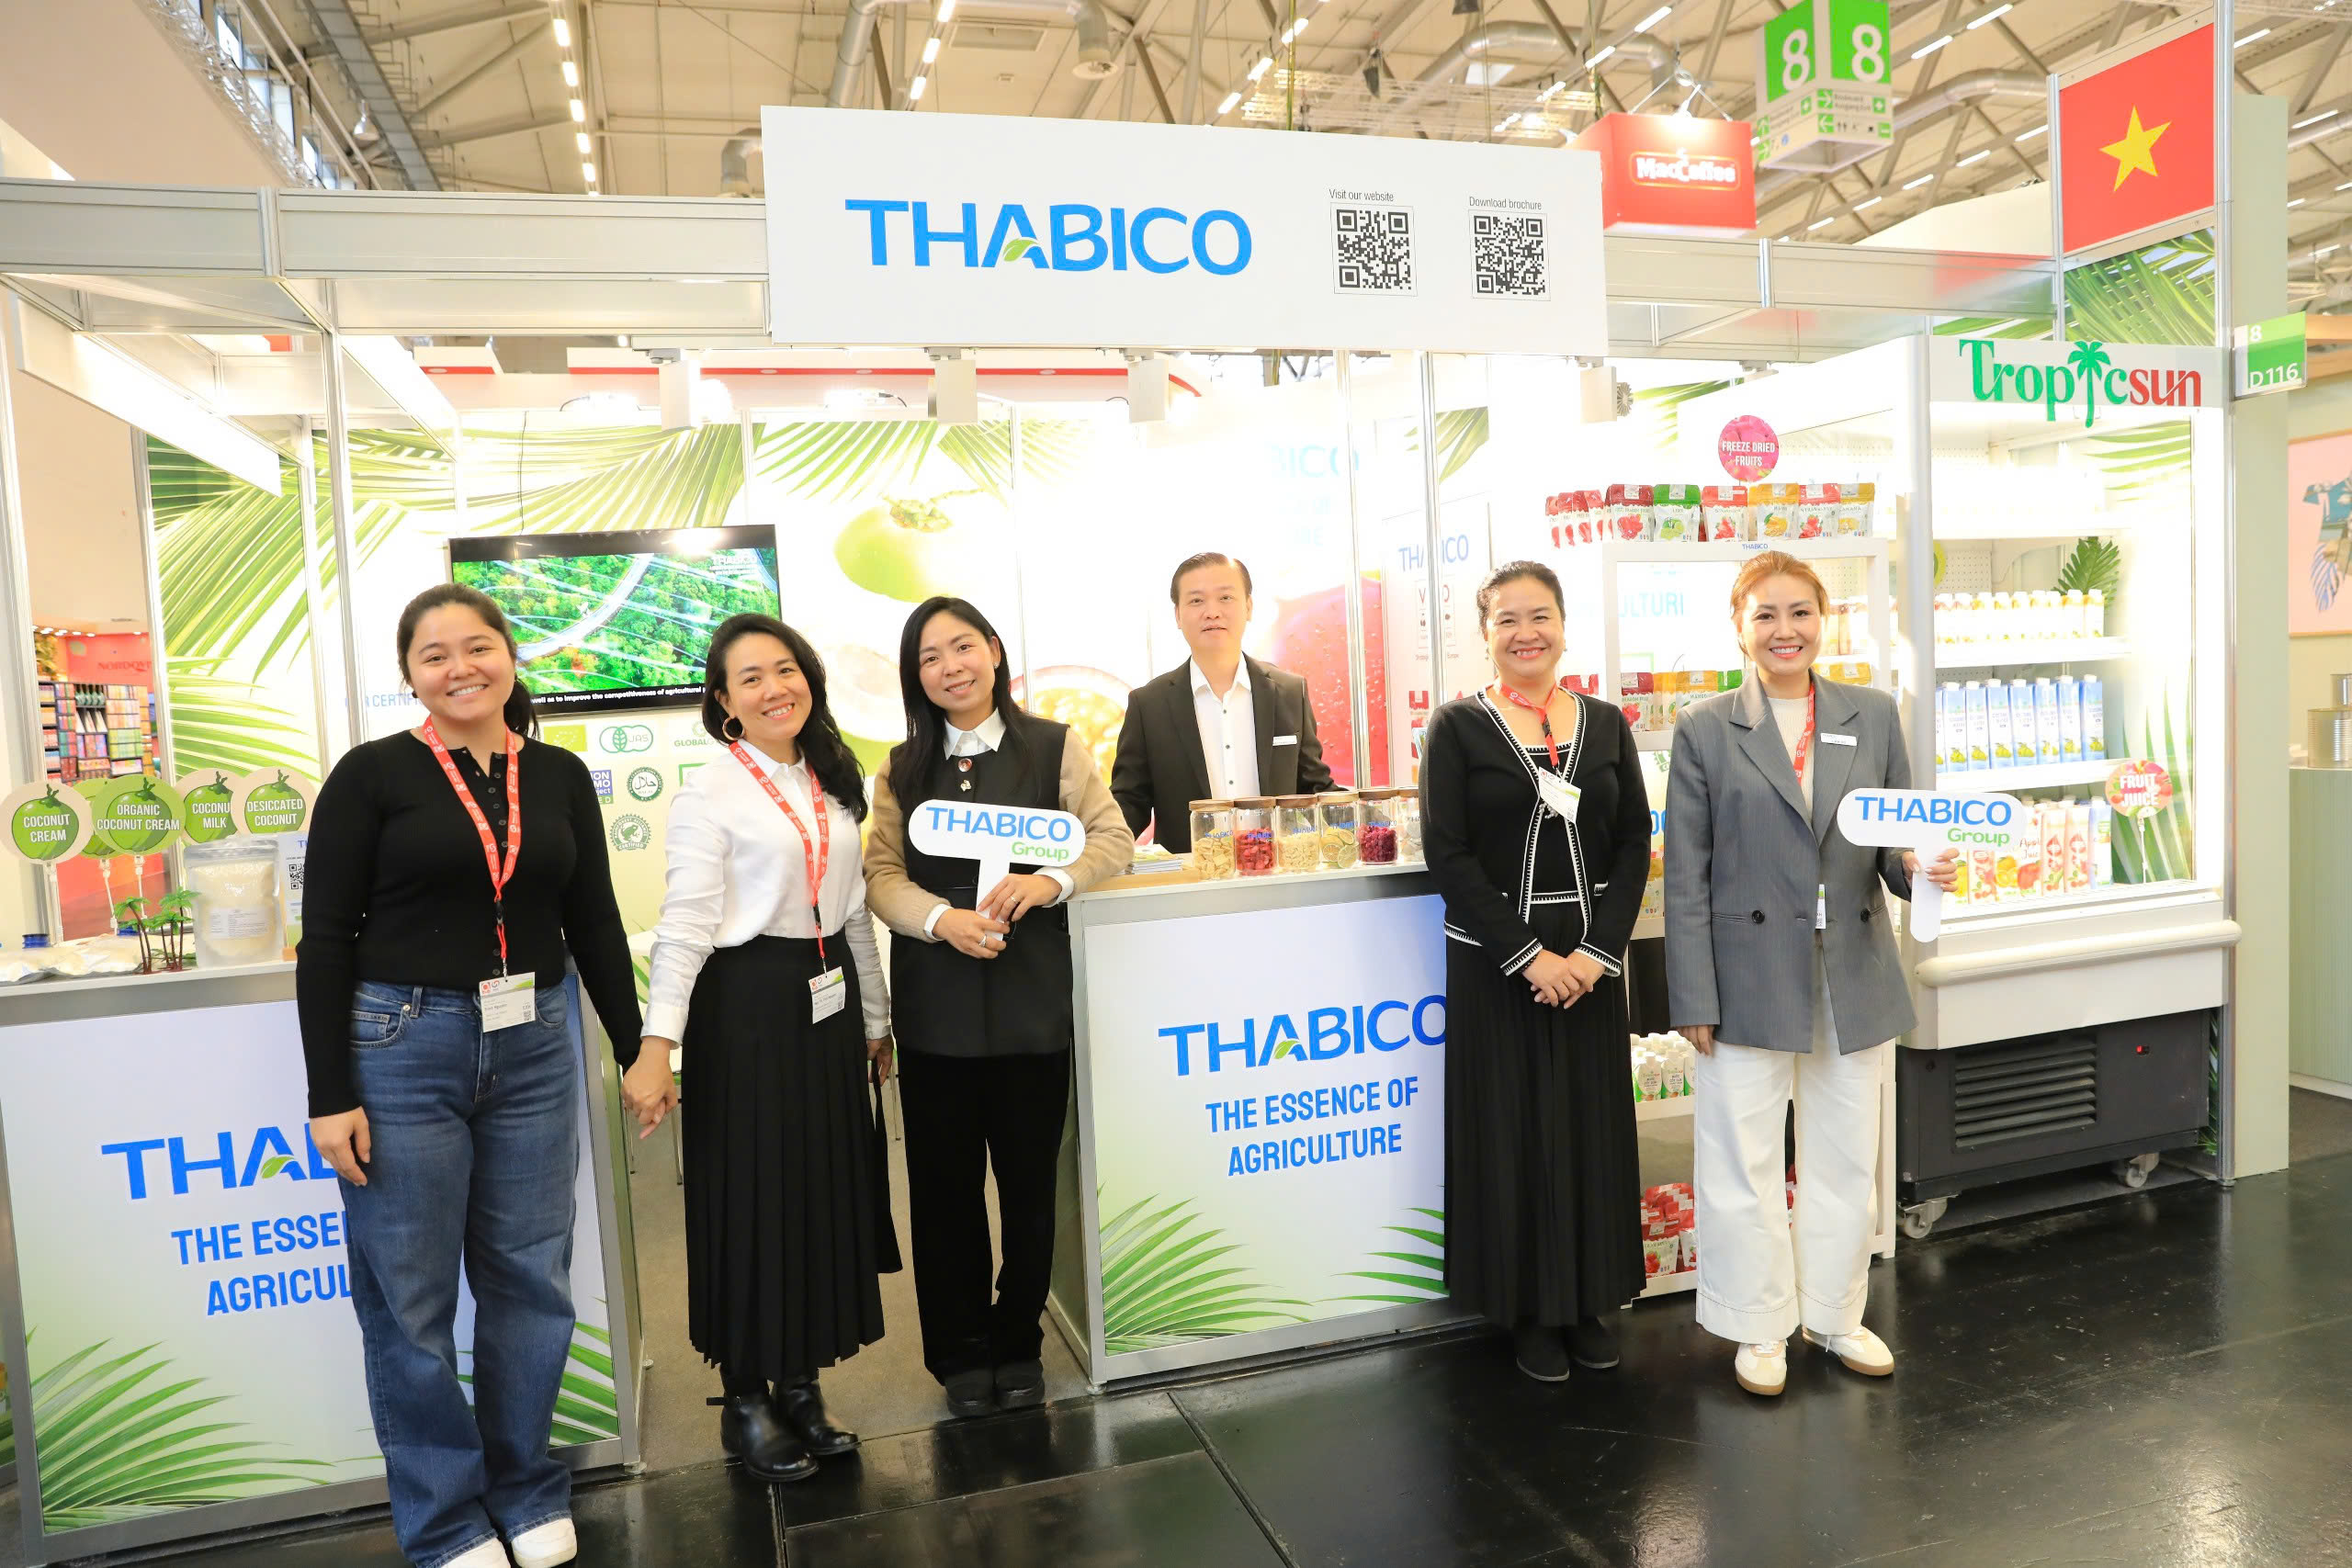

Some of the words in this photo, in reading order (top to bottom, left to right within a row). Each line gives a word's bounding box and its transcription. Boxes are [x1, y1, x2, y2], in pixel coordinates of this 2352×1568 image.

[1781, 28, 1810, 92] 8
[1851, 23, 1884, 84] 8
[1329, 188, 1347, 200] Visit
[1348, 192, 1363, 201] our
[1363, 191, 1394, 202] website
[1469, 196, 1507, 209] Download
[1508, 197, 1543, 210] brochure
[844, 198, 1252, 276] THABICO
[2249, 324, 2263, 343] 8
[1722, 441, 1750, 453] FREEZE
[1752, 442, 1776, 453] DRIED
[1735, 455, 1763, 467] FRUITS
[564, 694, 591, 703] improve
[657, 687, 664, 695] of
[665, 685, 702, 696] agricultural
[673, 739, 715, 748] GLOBALG
[594, 780, 611, 788] MO
[2120, 773, 2156, 789] FRUIT
[247, 798, 303, 812] DESICCATED
[2120, 791, 2159, 807] JUICE
[117, 804, 160, 817] ORGANIC
[192, 802, 230, 815] COCONU
[1855, 796, 2012, 827] THABICO
[23, 814, 70, 828] COCONUT
[96, 818, 142, 830] COCONUT
[145, 818, 180, 831] CREAM
[202, 816, 227, 829] MILK
[254, 813, 298, 827] COCONUT
[925, 807, 1071, 842] THABICO
[29, 829, 67, 843] CREAM
[1947, 828, 2010, 847] Group
[1012, 841, 1069, 862] Group
[1158, 994, 1446, 1077] THABICO
[1205, 1098, 1258, 1134] THE
[1265, 1081, 1381, 1126] ESSENCE
[1387, 1076, 1419, 1109] OF
[1227, 1123, 1402, 1177] AGRICULTURE
[171, 1224, 243, 1265] THE
[256, 1211, 347, 1257] ESSE
[207, 1264, 352, 1316] AGRICUL
